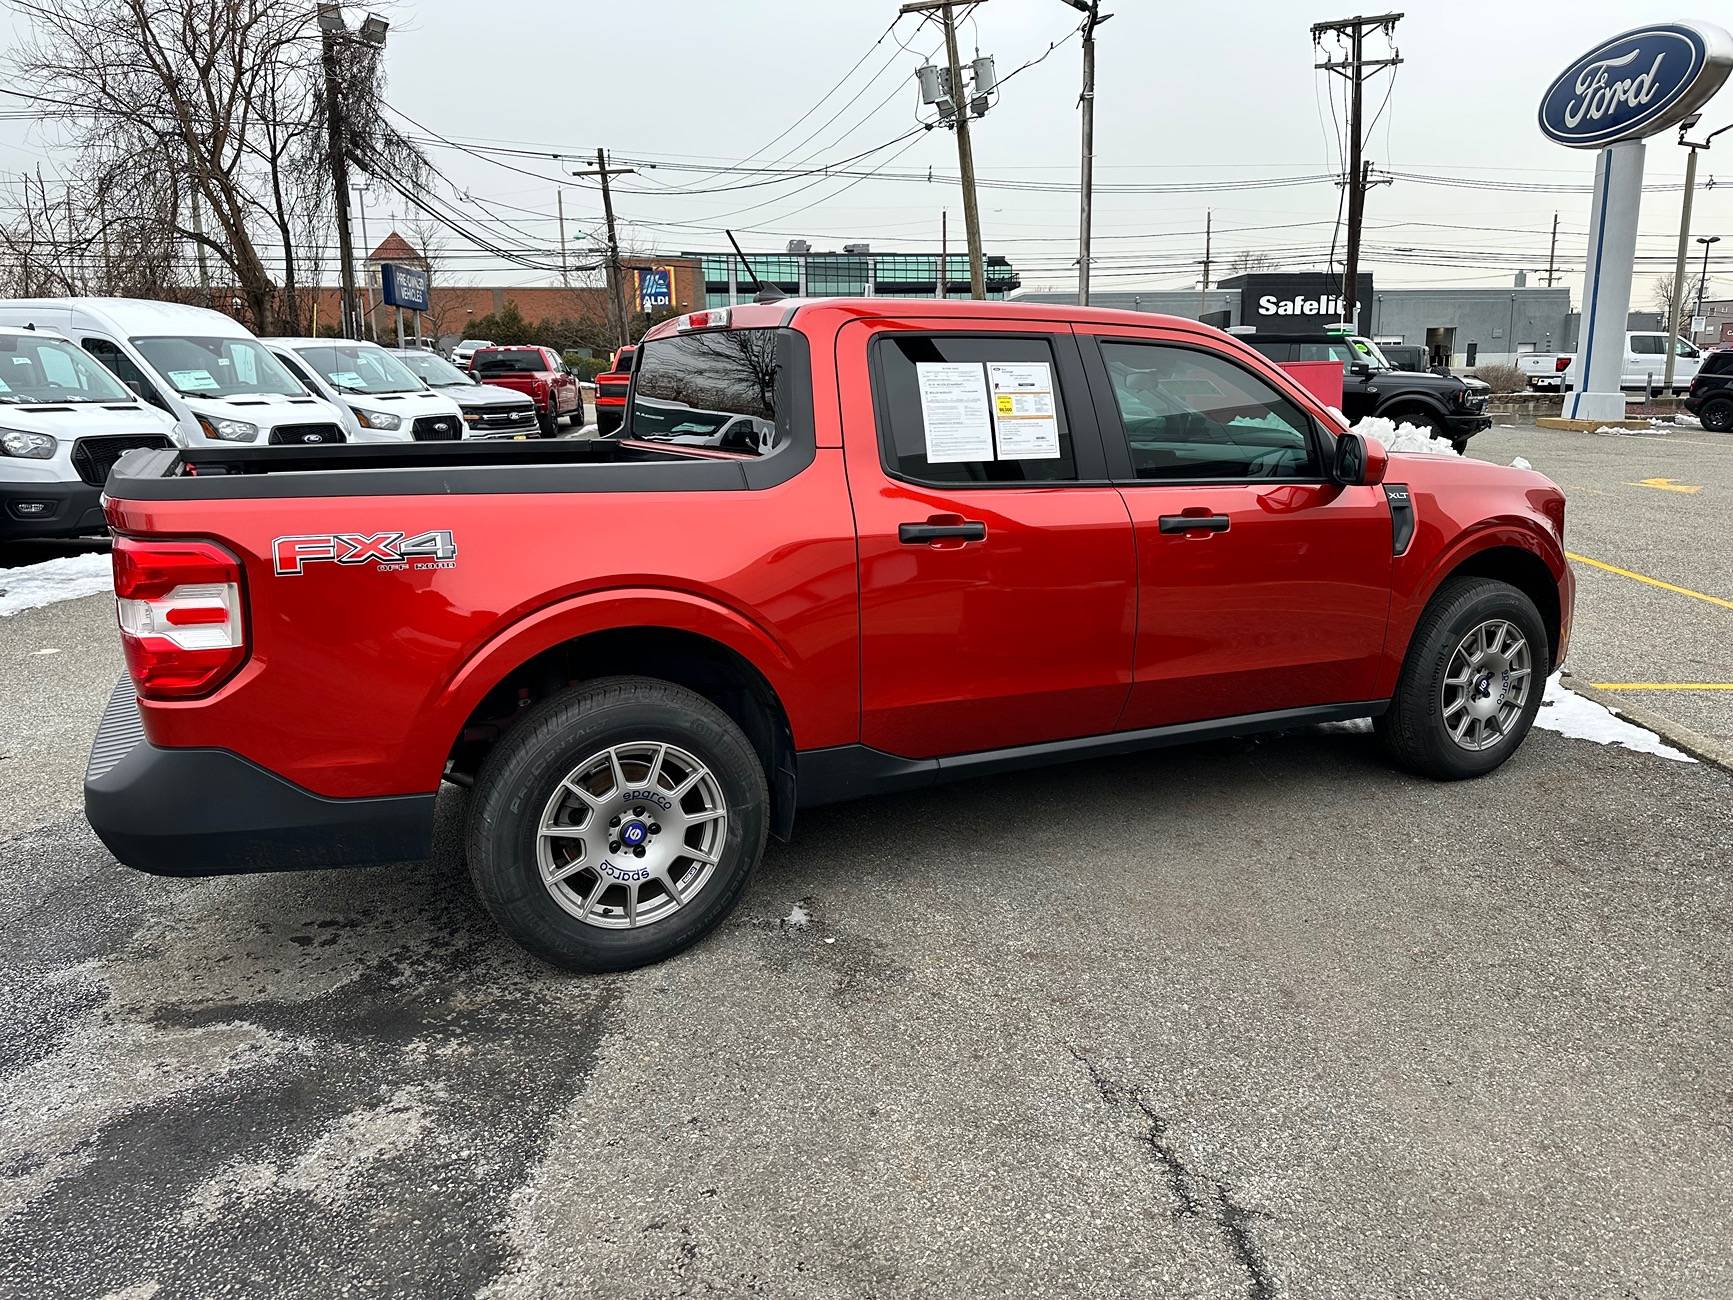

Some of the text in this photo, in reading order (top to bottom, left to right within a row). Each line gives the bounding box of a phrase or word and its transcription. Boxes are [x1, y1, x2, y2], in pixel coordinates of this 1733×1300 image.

[1564, 48, 1667, 129] Ford
[400, 286, 423, 303] VEHICLES
[642, 296, 669, 305] ALDI
[271, 529, 458, 577] FX4
[377, 561, 457, 572] OFF ROAD
[1496, 669, 1509, 705] sparco
[623, 789, 673, 811] sparco
[599, 861, 650, 883] sparco
